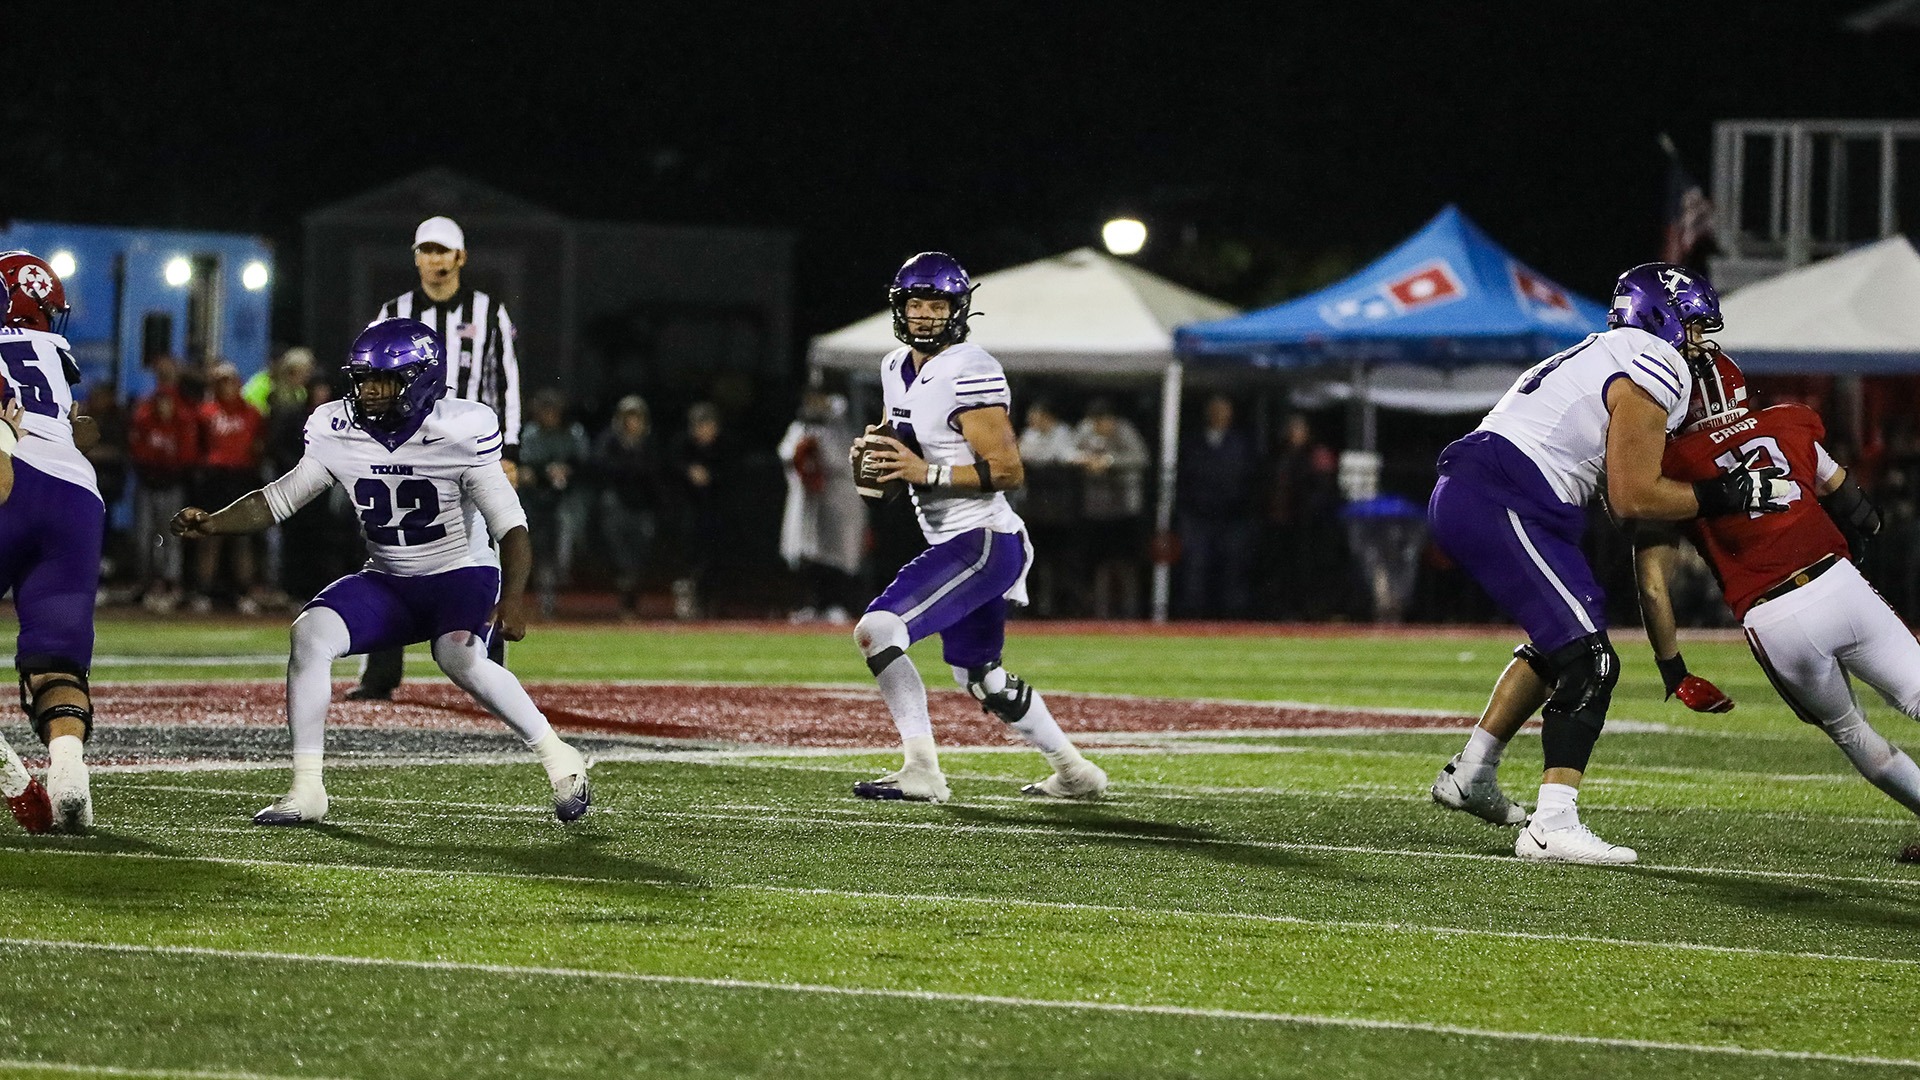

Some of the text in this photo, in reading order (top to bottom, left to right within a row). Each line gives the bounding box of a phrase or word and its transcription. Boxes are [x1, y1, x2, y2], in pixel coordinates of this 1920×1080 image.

[0, 341, 59, 419] 5
[1697, 411, 1741, 430] AUSTIN PEAY
[1709, 418, 1758, 444] CRISP
[354, 478, 447, 546] 22
